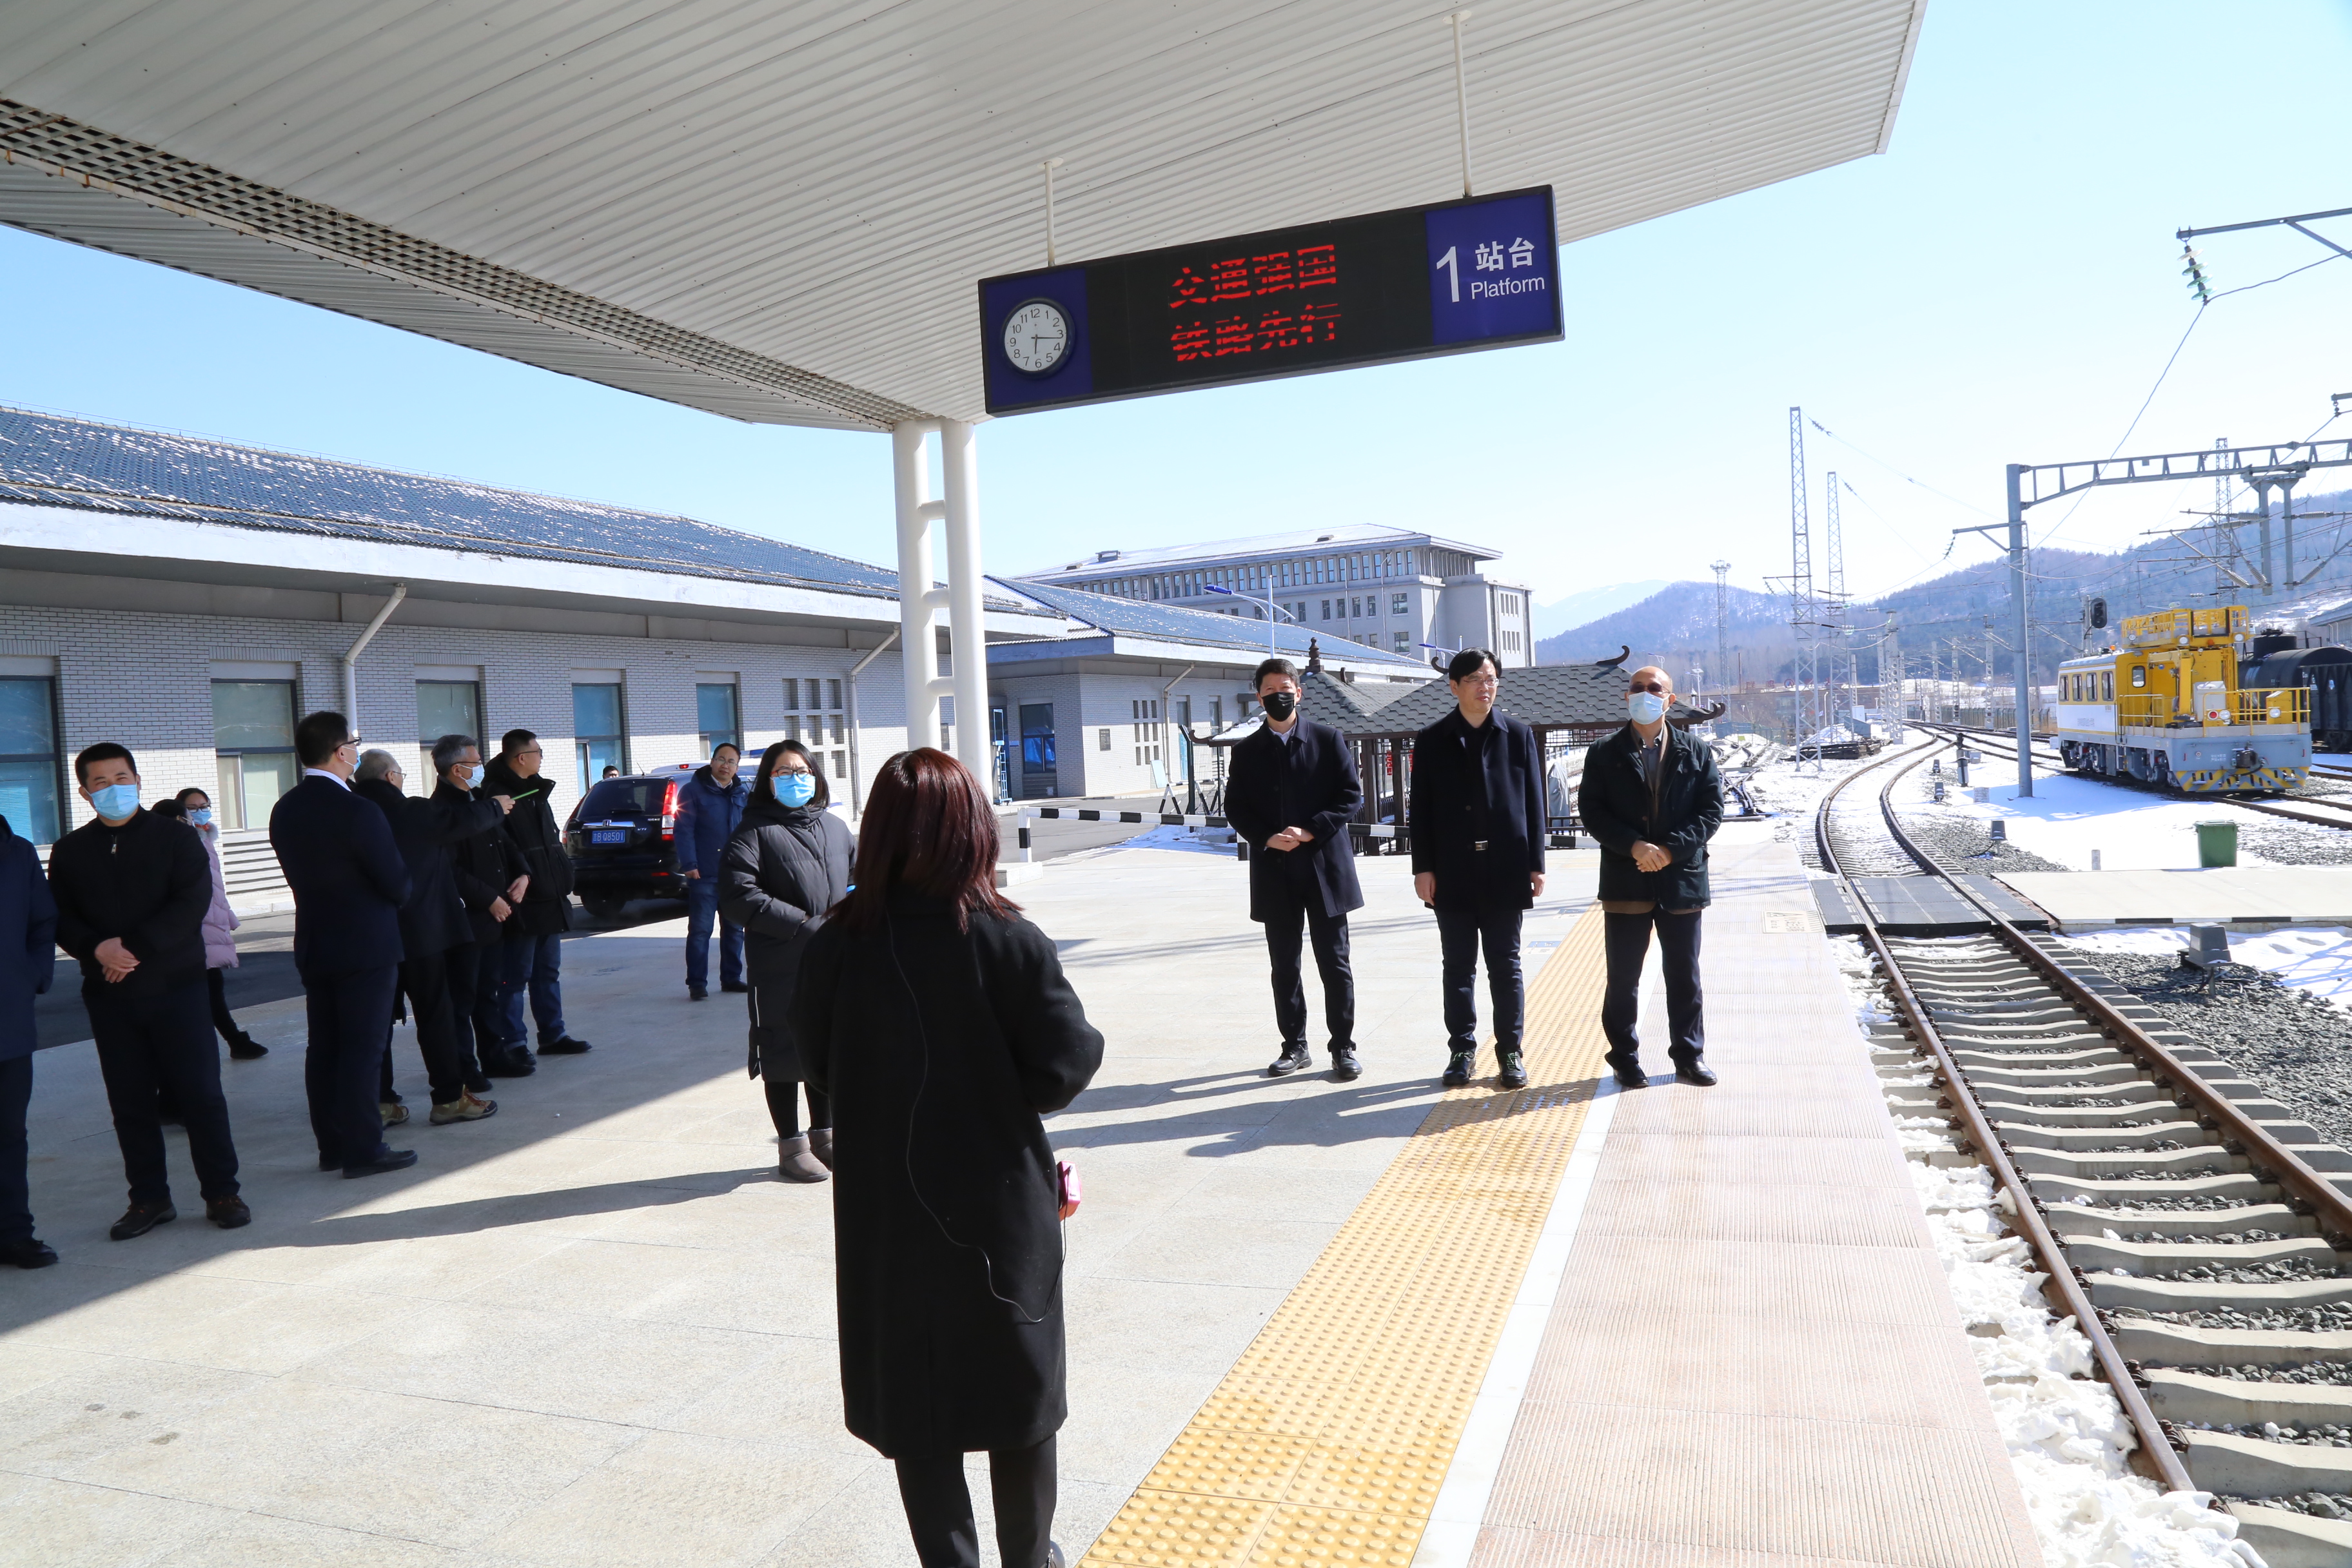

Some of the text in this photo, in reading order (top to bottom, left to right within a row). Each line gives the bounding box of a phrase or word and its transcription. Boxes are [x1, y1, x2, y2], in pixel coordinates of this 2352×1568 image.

[1475, 237, 1534, 271] 站台
[1170, 244, 1337, 308] 交通强国
[1436, 246, 1460, 302] 1
[1471, 277, 1545, 300] Platform
[1030, 308, 1040, 318] 12
[1045, 310, 1049, 319] 1
[1020, 314, 1027, 324] 11
[1053, 317, 1059, 327] 2
[1012, 324, 1021, 333] 10
[1057, 329, 1064, 338] 3
[1170, 303, 1342, 362] 铁路先行
[1010, 337, 1016, 347] 9
[1054, 342, 1061, 351] 4
[1014, 349, 1021, 358] 8
[1046, 353, 1053, 362] 5
[1023, 356, 1030, 366] 7
[1035, 358, 1042, 368] 6
